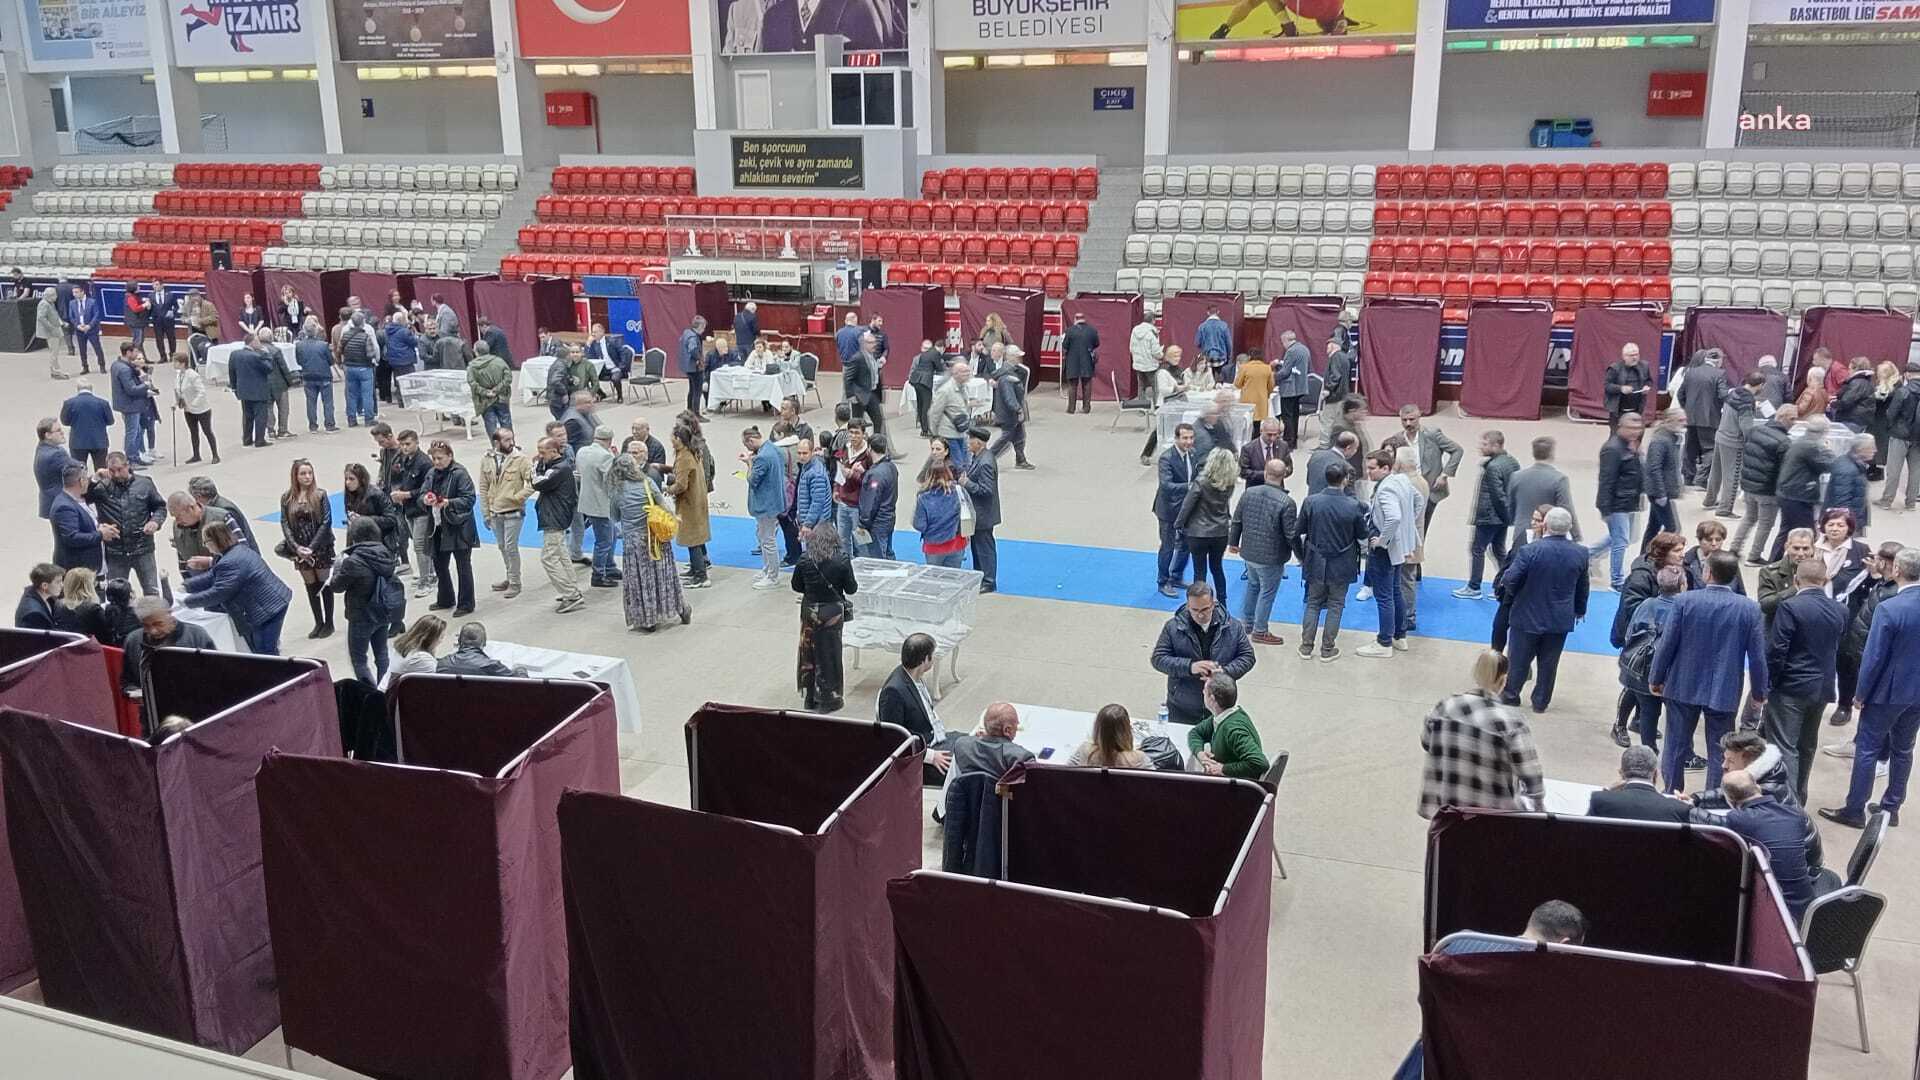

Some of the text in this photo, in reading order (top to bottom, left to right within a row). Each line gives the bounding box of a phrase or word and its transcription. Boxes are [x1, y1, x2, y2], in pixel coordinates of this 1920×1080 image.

[1790, 7, 1850, 21] BASKETBOL
[1854, 3, 1875, 20] LİGİ
[979, 14, 1103, 38] BELEDİYESİ
[743, 141, 806, 155] Ben sporcunun
[760, 157, 781, 170] çevik
[785, 160, 794, 168] ve
[816, 157, 853, 168] zamanda
